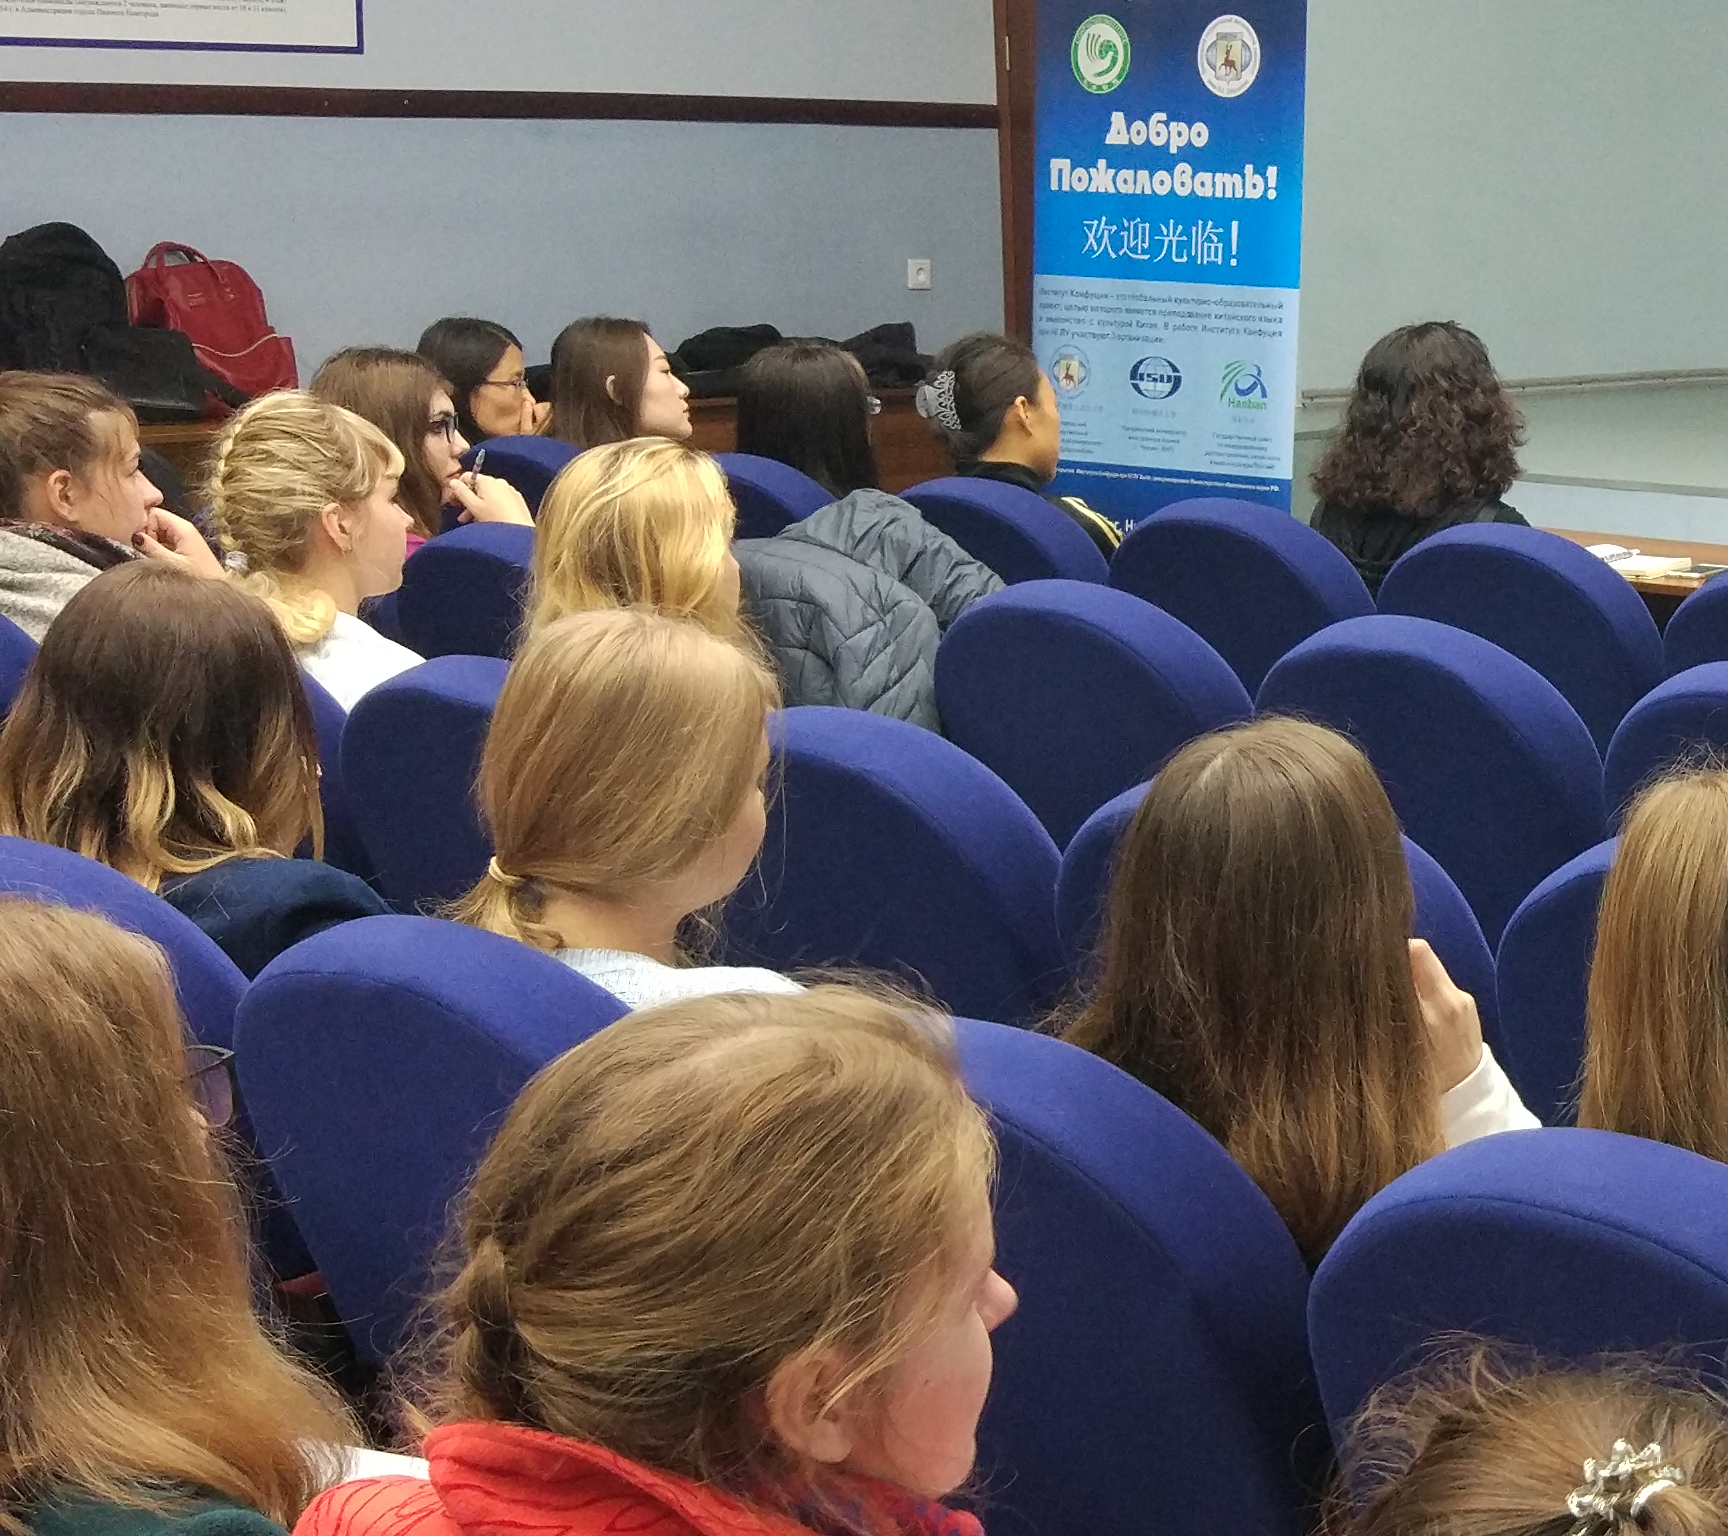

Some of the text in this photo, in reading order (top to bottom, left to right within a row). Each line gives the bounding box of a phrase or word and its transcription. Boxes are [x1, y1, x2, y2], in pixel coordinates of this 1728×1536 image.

[1105, 111, 1210, 154] Добро
[1049, 158, 1278, 200] Пожаловать!
[1082, 215, 1239, 267] 欢迎光临!
